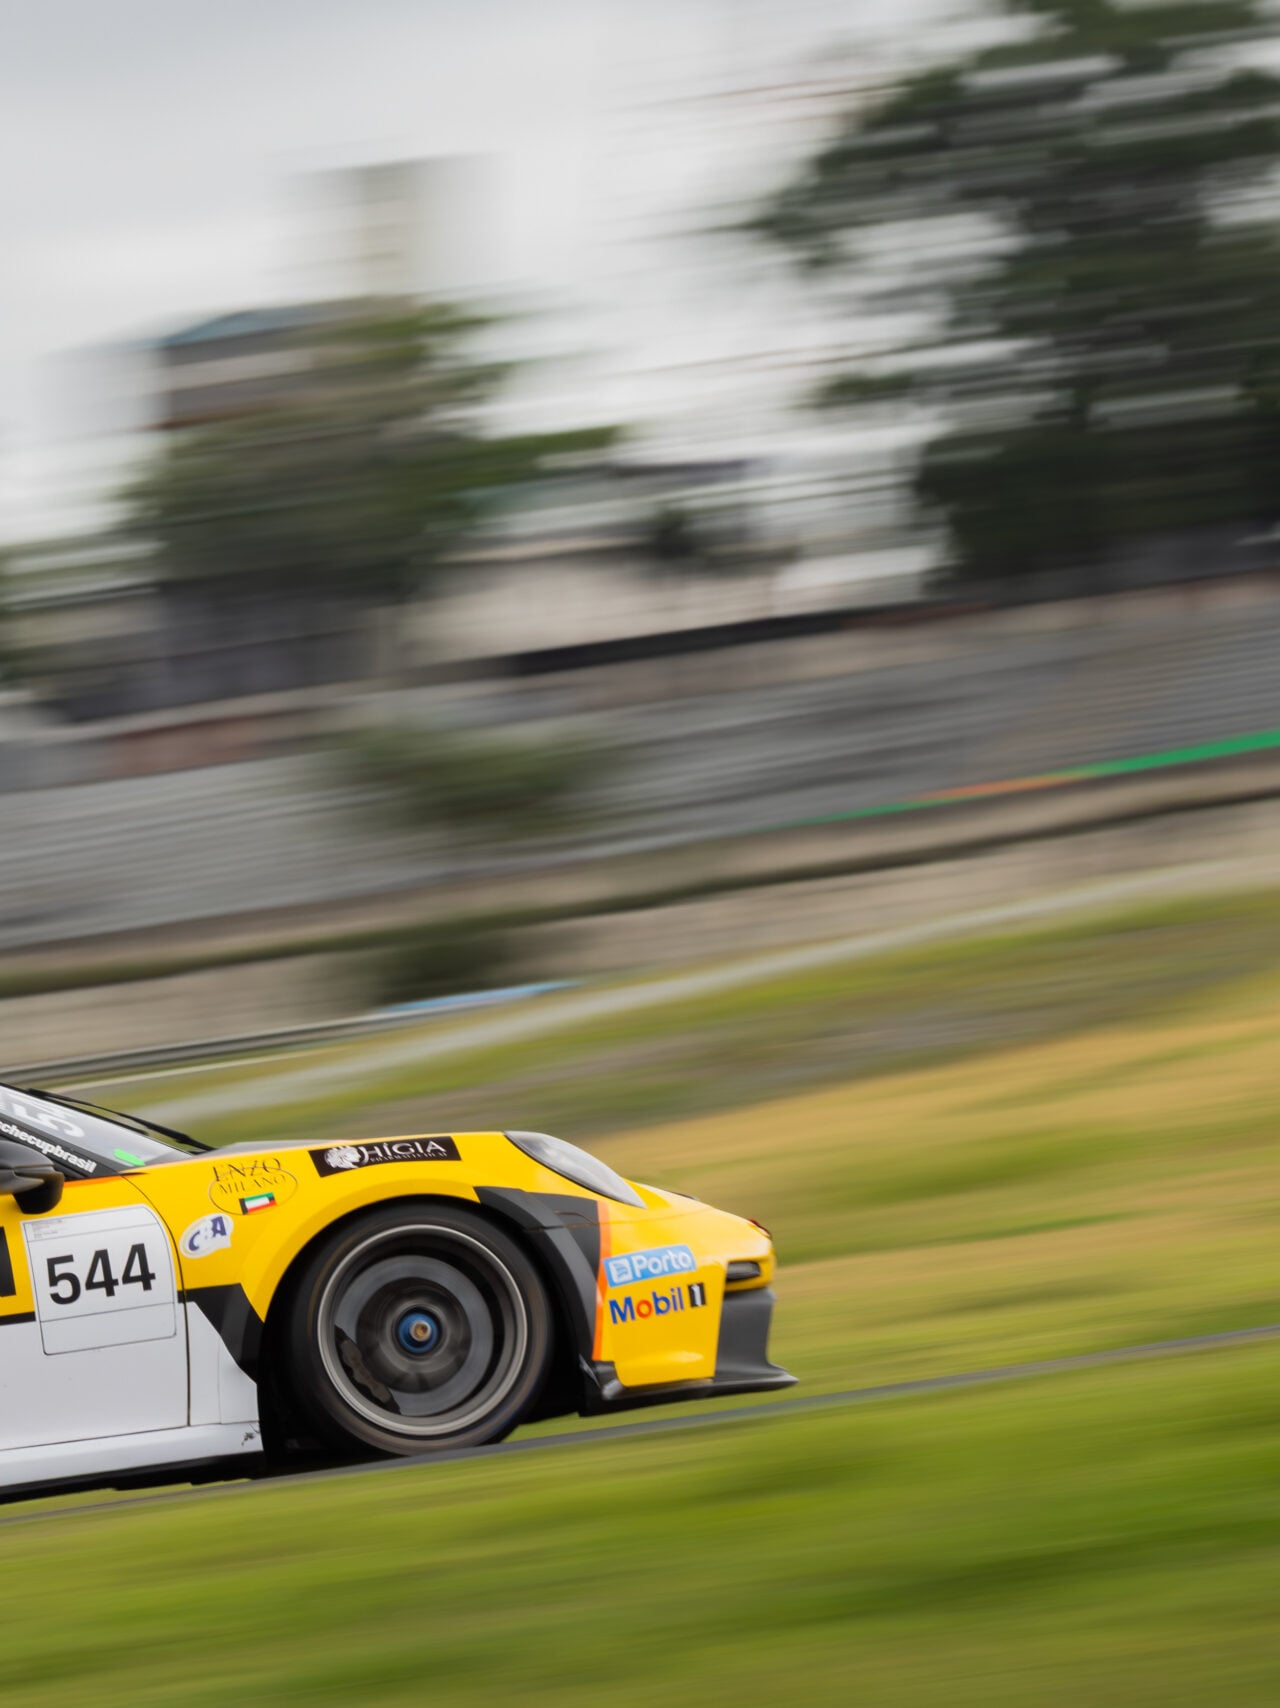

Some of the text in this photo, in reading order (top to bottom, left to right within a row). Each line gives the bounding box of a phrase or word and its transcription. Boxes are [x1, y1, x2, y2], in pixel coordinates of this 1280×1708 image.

[46, 1243, 157, 1306] 544
[631, 1250, 693, 1279] Porto
[608, 1286, 685, 1326] Mobil
